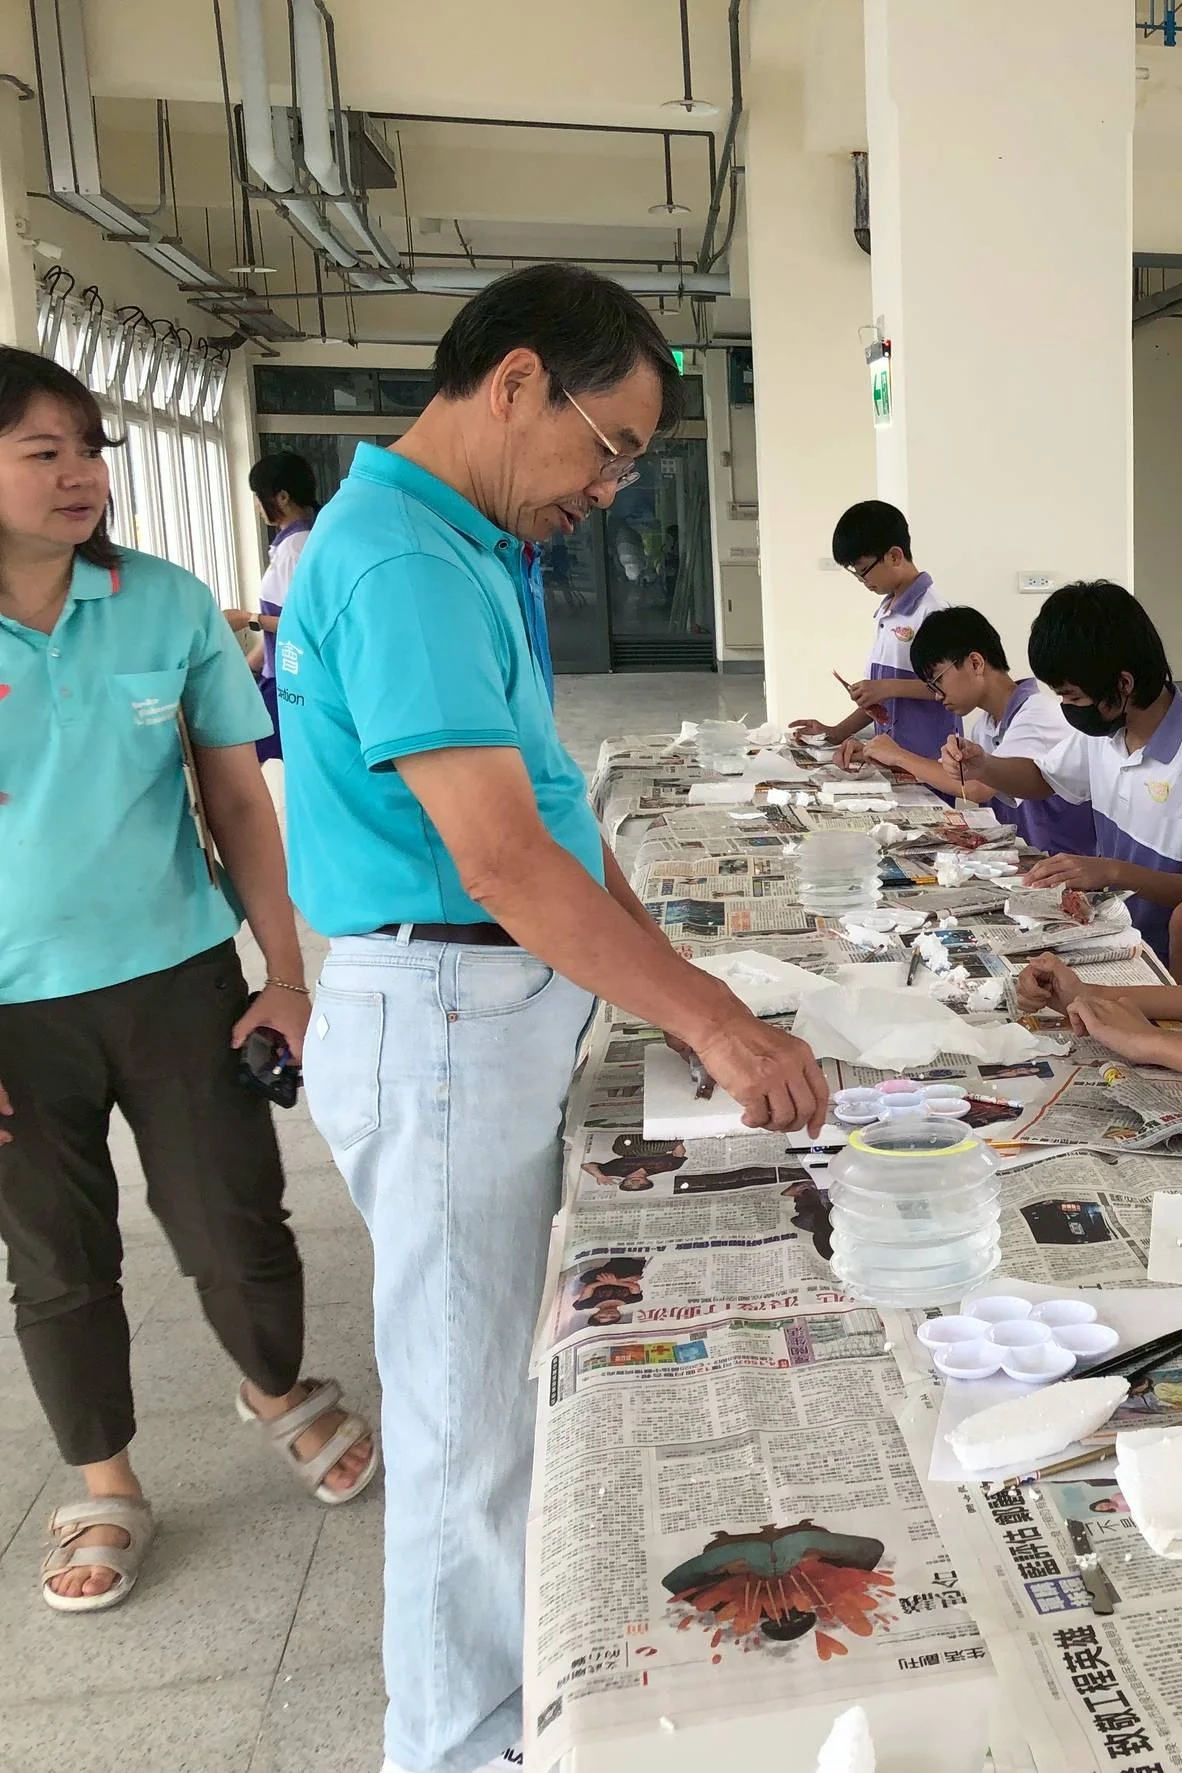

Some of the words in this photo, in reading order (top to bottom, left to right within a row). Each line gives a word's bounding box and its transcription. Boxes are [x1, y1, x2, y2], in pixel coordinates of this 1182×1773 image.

[1052, 1624, 1154, 1759] 致敬工程英雄
[502, 1747, 523, 1765] ILA
